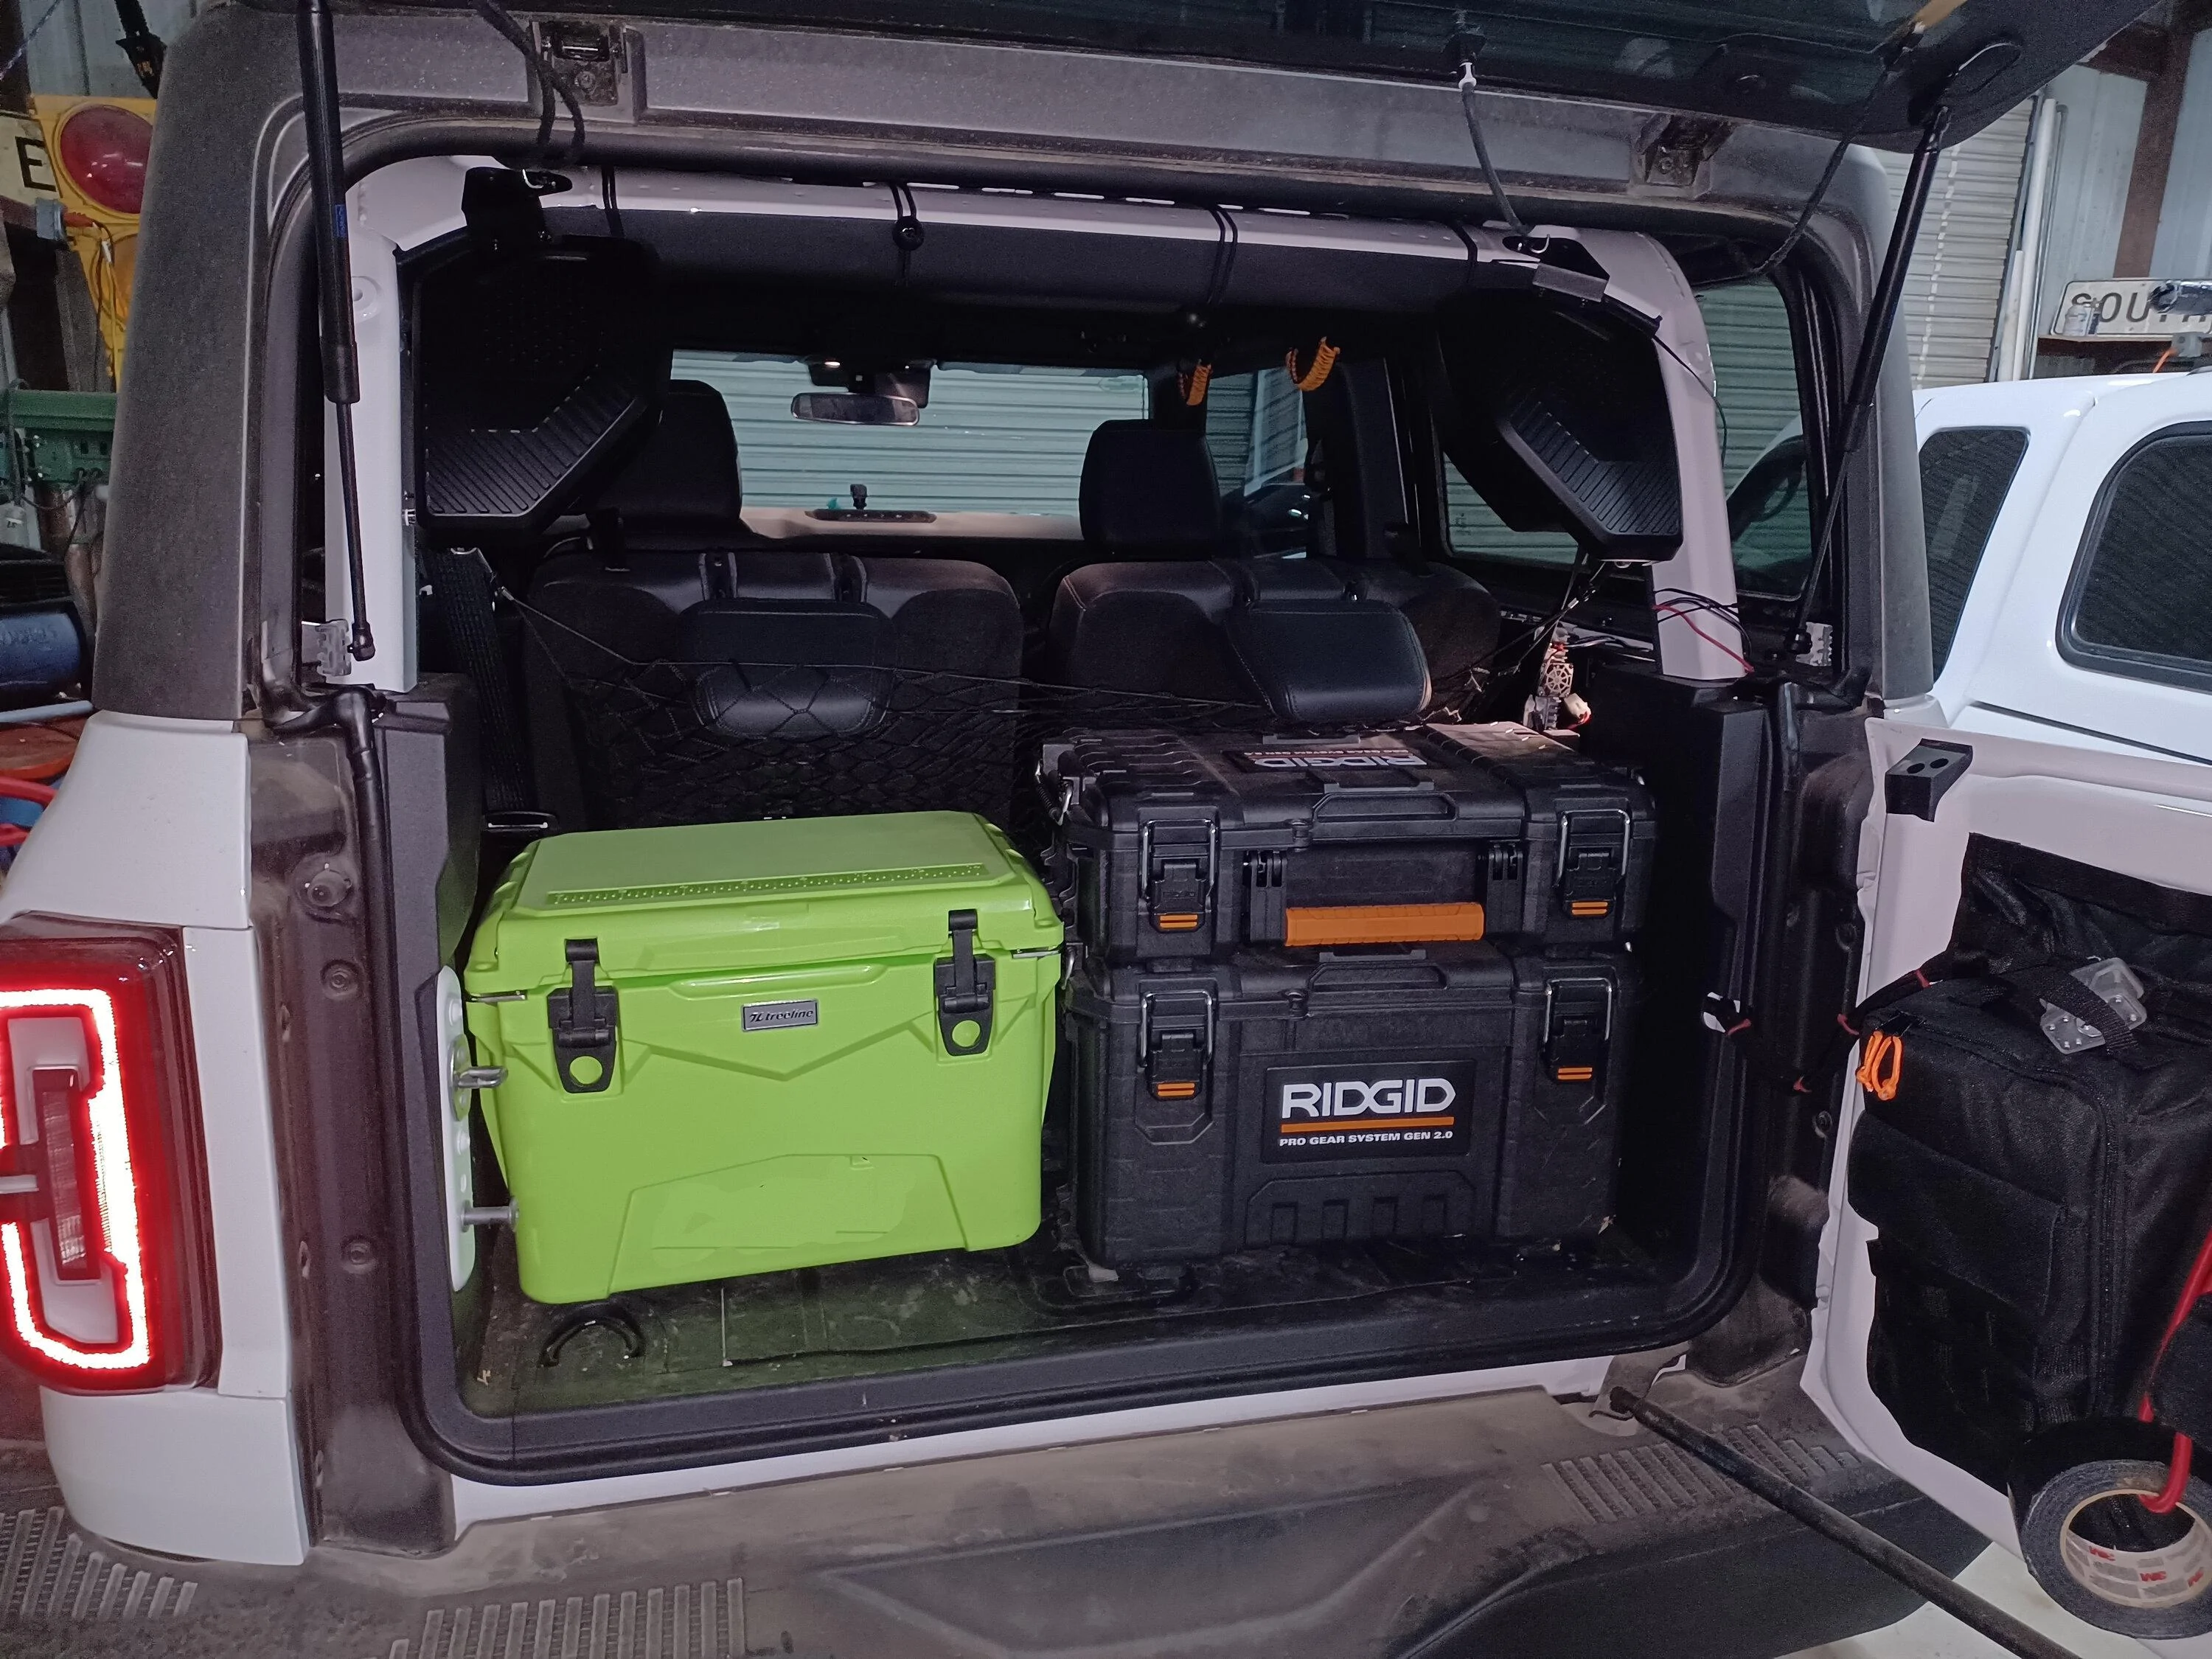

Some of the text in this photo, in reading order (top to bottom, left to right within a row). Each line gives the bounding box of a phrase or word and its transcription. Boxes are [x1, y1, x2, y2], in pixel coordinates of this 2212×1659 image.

[15, 136, 57, 192] E
[1254, 756, 1427, 768] RIDGID
[765, 1009, 813, 1022] treeline
[1281, 1077, 1456, 1119] RIDGID
[1279, 1131, 1453, 1147] PRO GEAR SYSTEM GEN 2.0
